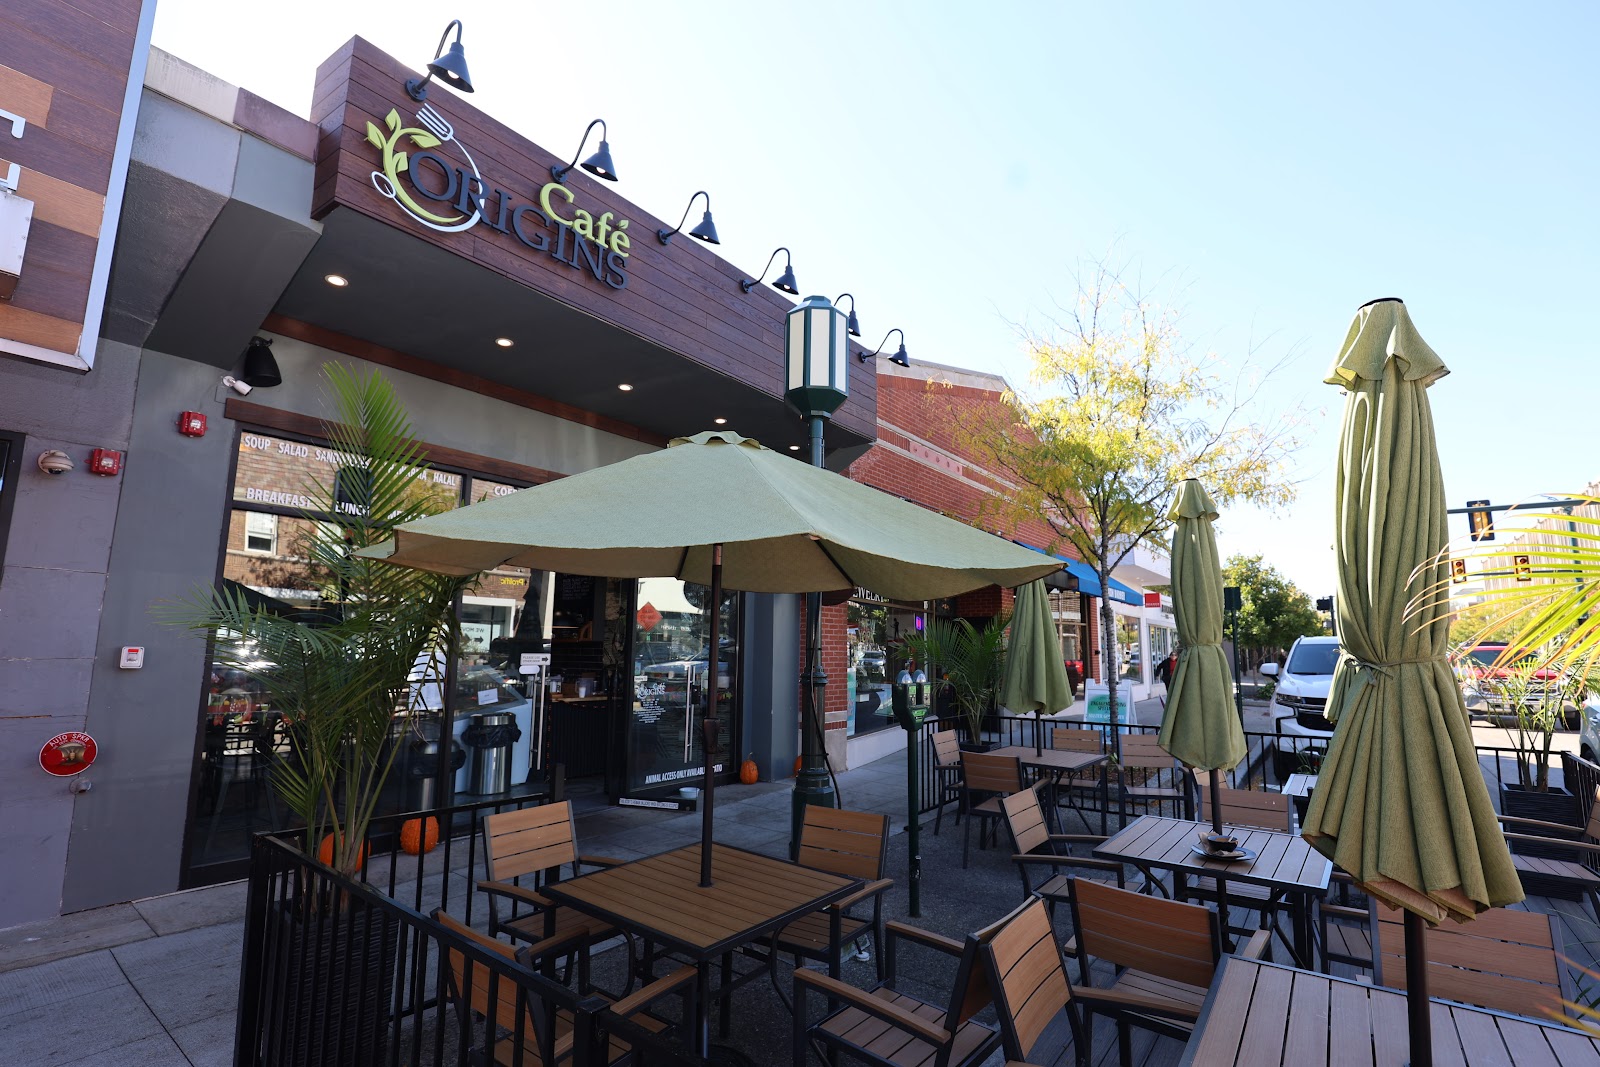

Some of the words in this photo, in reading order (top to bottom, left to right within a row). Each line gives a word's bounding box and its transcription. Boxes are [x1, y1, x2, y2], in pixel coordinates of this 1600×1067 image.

[408, 151, 629, 290] ORIGINS
[540, 182, 631, 258] Café
[244, 435, 271, 450] SOUP
[278, 442, 308, 458] SALAD
[433, 472, 456, 486] HALAL
[246, 487, 312, 508] BREAKFAST
[335, 501, 370, 516] LUNCH
[852, 586, 884, 603] EWELR
[49, 734, 68, 747] AUTO
[71, 733, 90, 743] SPKR
[645, 773, 662, 784] ANIMAL
[661, 770, 677, 782] ACCESS
[676, 769, 687, 779] ONLY
[686, 766, 706, 777] AVAILABL
[712, 763, 723, 773] ATIO
